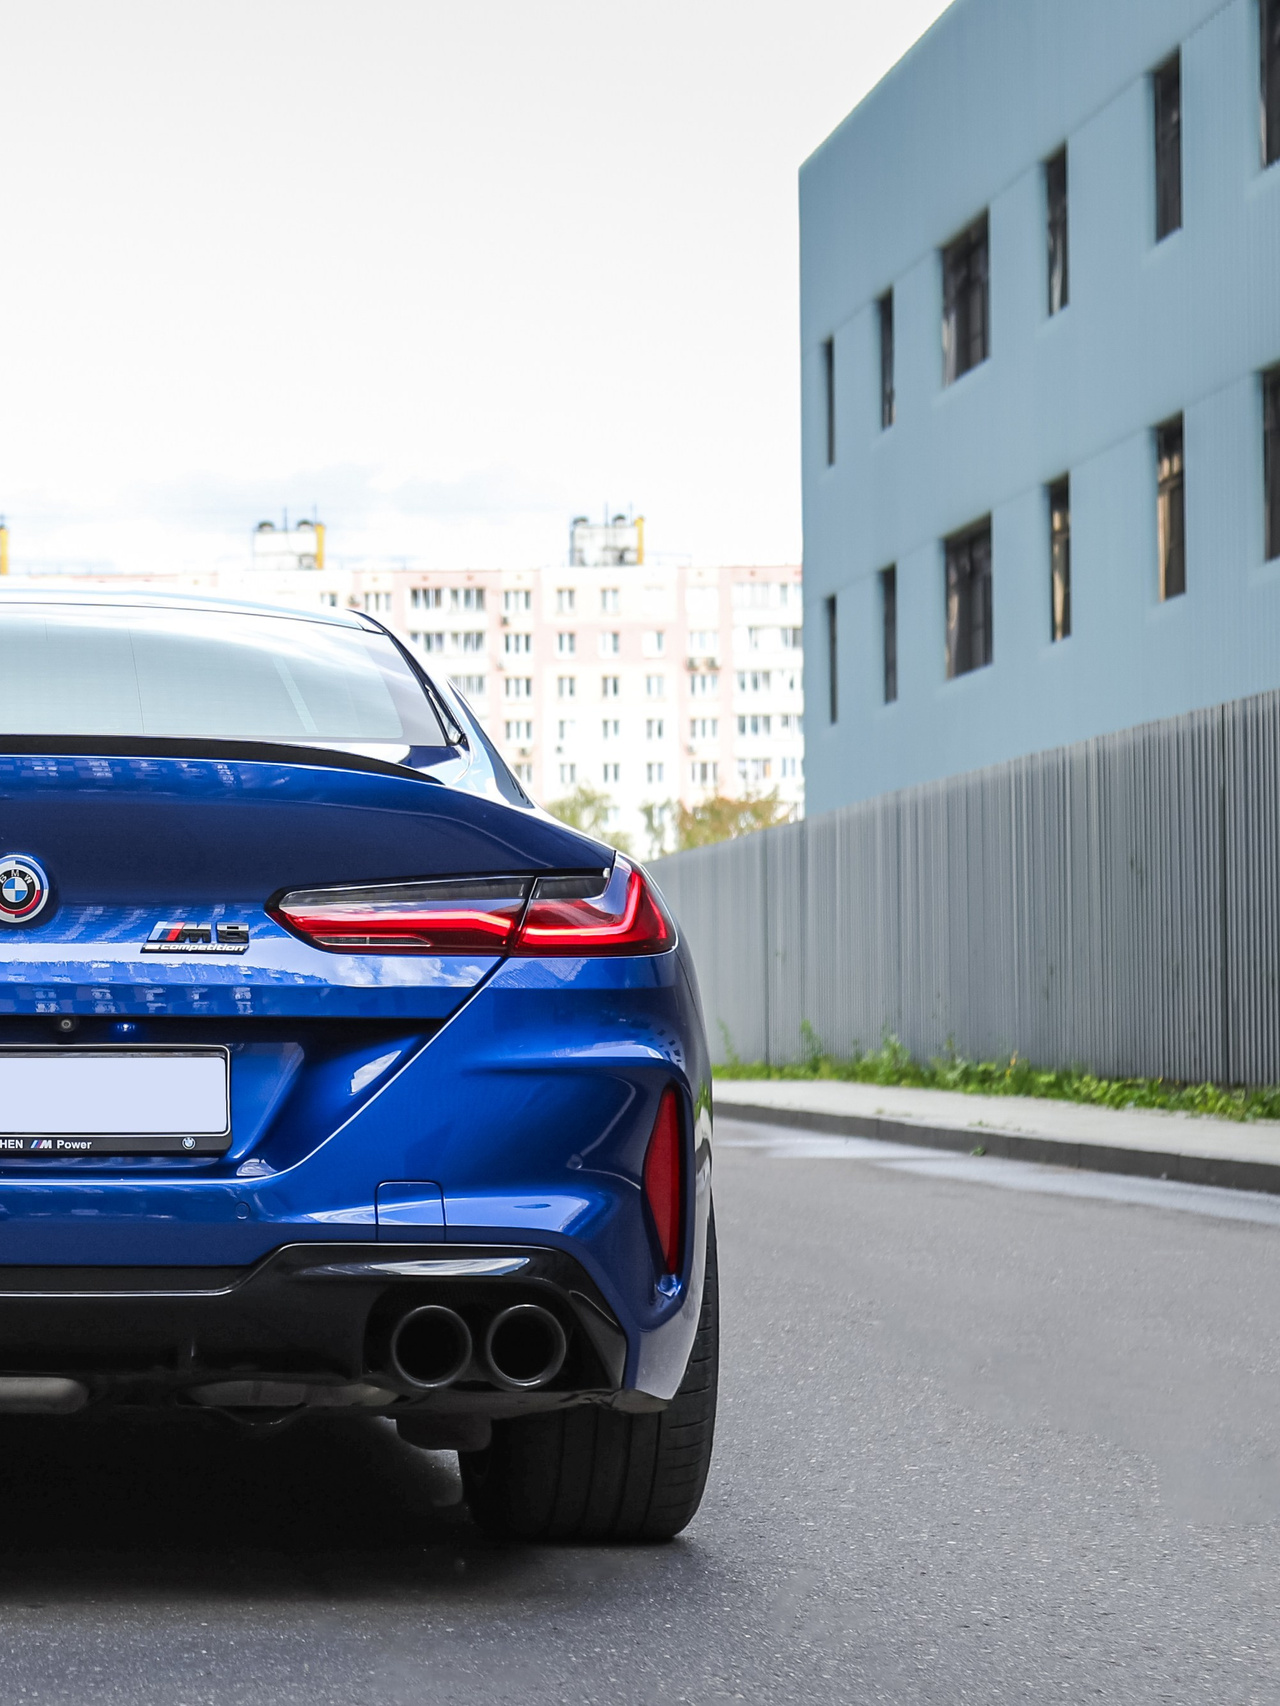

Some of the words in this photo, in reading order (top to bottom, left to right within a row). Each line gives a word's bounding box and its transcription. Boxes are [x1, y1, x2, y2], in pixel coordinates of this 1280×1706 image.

[179, 921, 250, 943] M8
[160, 943, 246, 952] competition
[56, 1140, 92, 1149] Power
